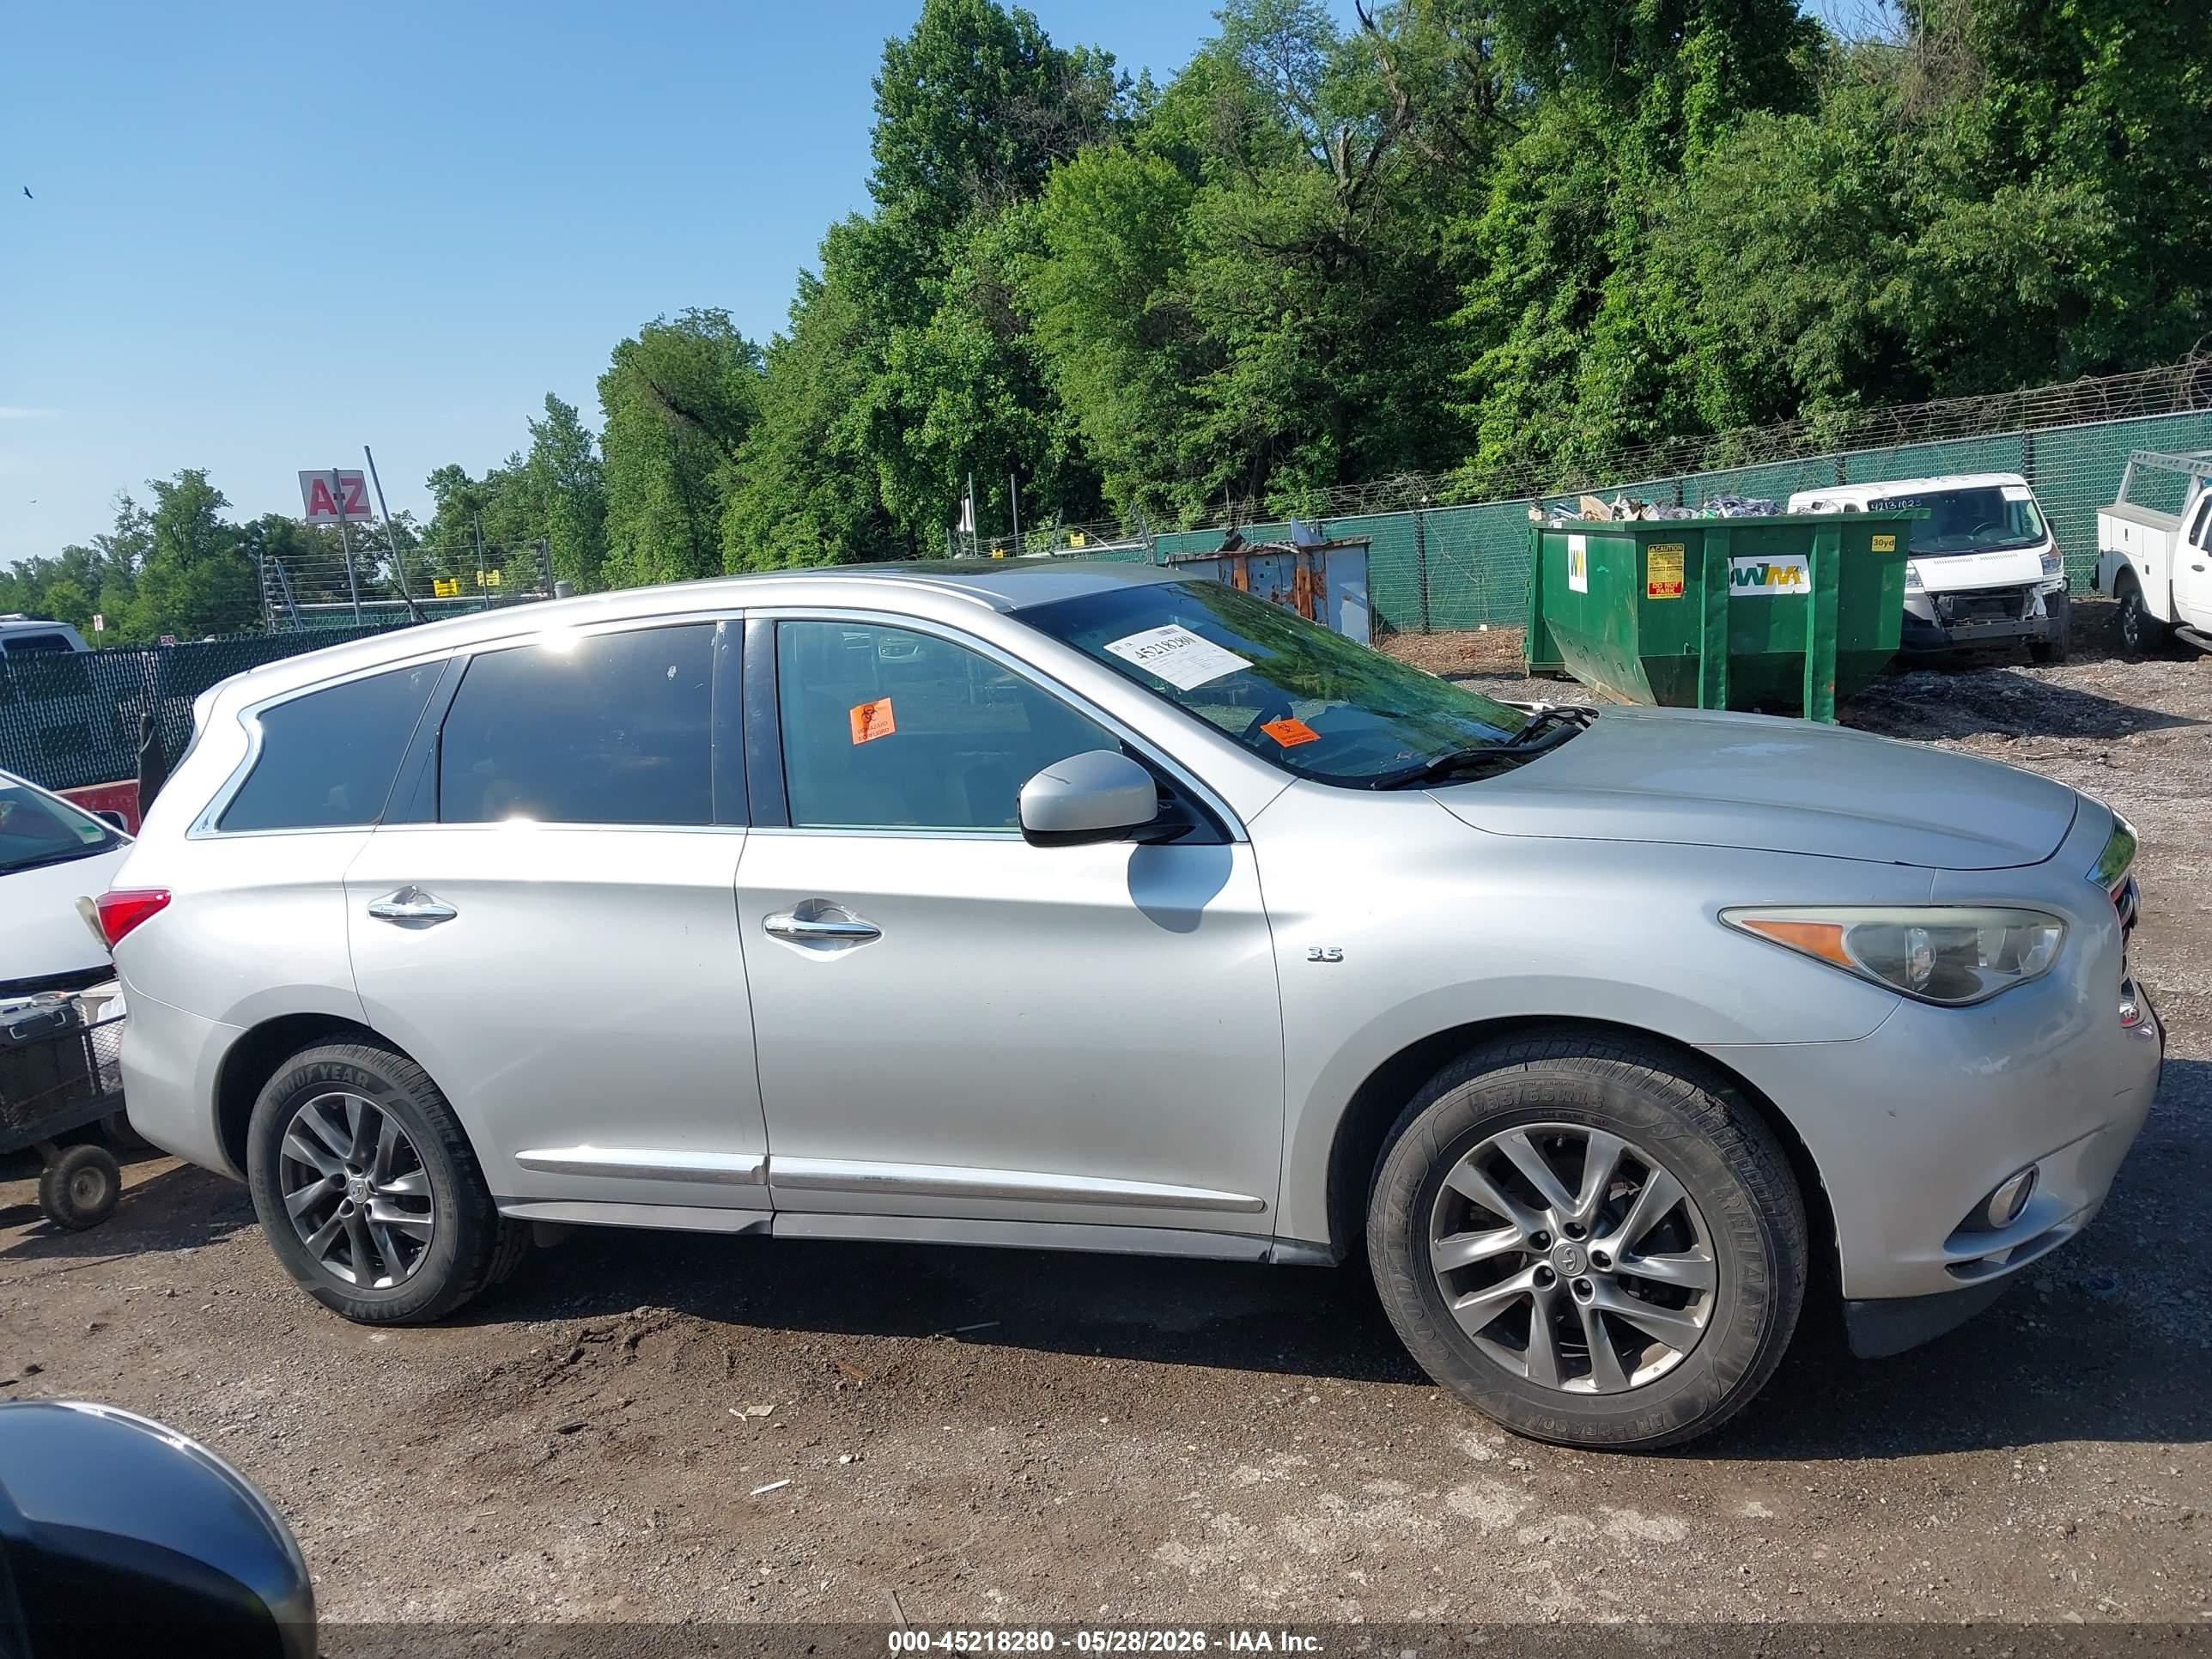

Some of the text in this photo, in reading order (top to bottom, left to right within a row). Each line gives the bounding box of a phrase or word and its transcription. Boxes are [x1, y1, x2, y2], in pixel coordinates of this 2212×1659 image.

[309, 477, 368, 515] A-Z
[1873, 538, 1894, 548] 30yd
[1571, 549, 1584, 578] WM
[1735, 563, 1802, 586] WM
[161, 636, 175, 645] 20
[1134, 635, 1197, 661] 45218280
